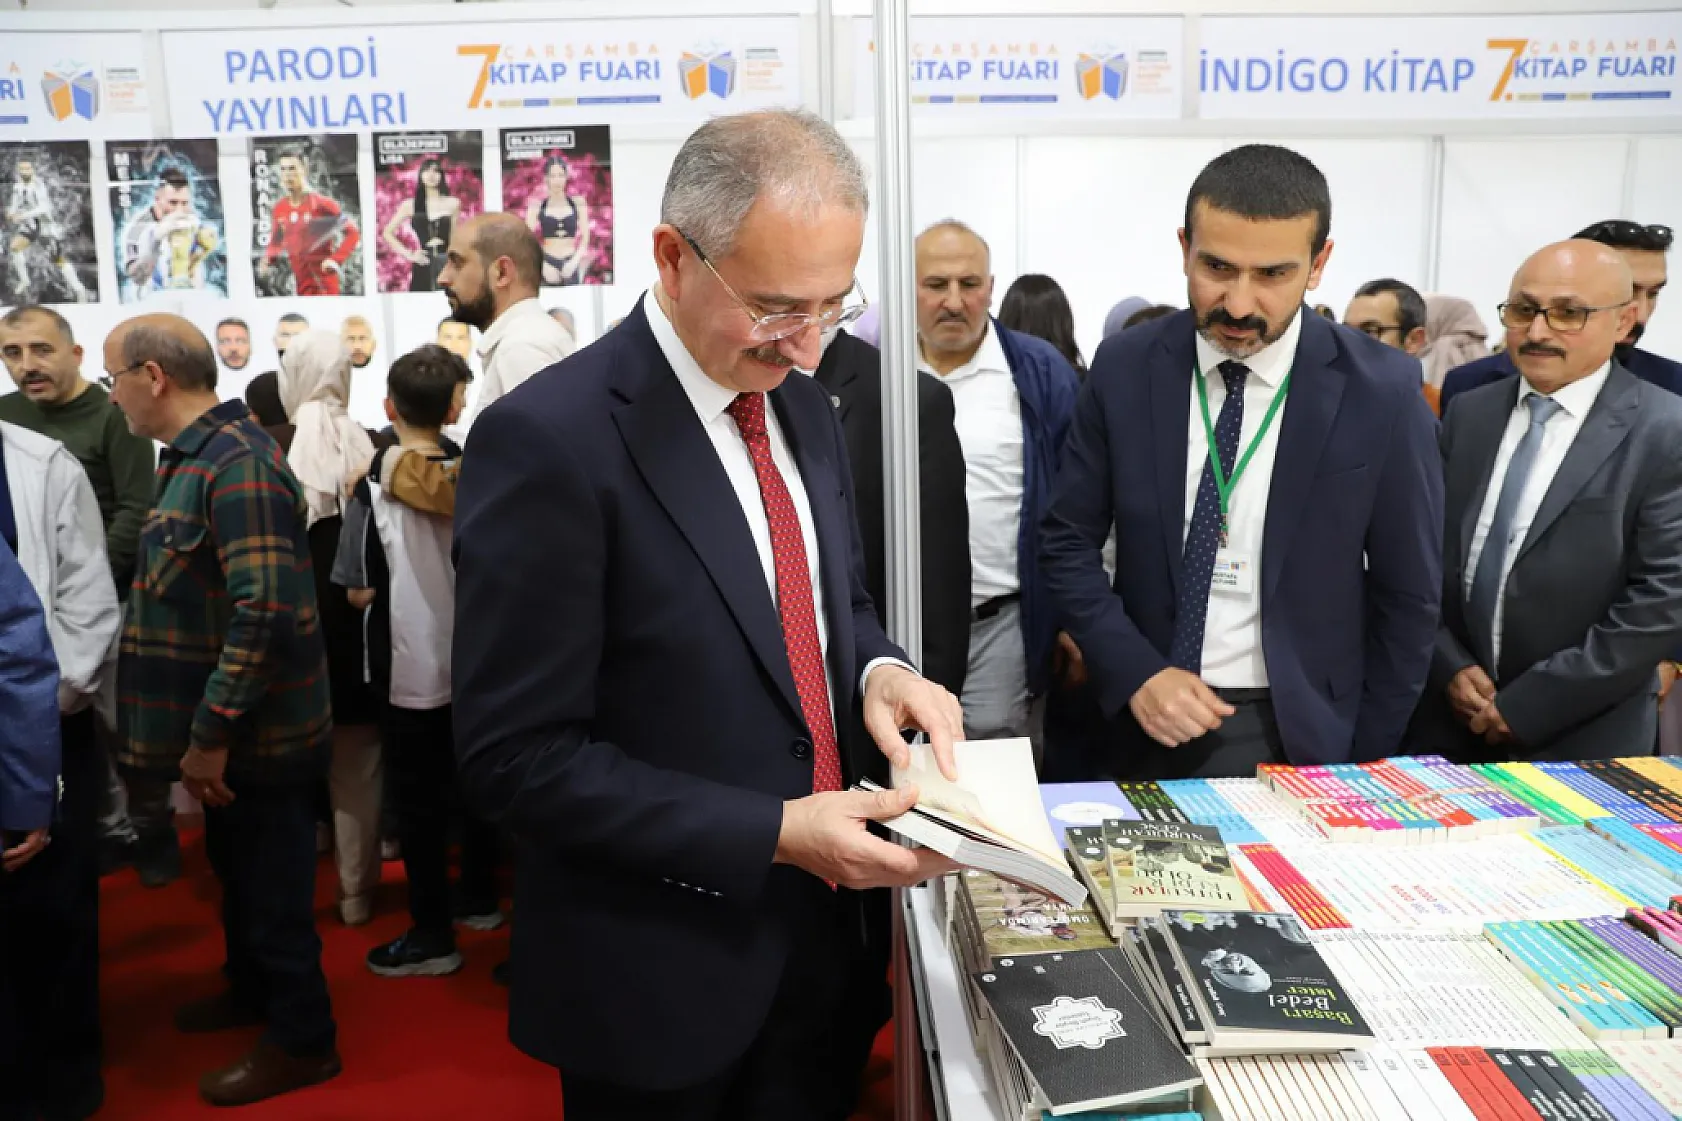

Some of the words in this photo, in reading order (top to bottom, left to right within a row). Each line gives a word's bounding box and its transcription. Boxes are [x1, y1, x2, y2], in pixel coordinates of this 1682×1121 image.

[504, 42, 660, 62] ÇARŞAMBA
[1530, 38, 1676, 56] ÇARŞAMBA
[225, 36, 377, 84] PARODİ
[983, 60, 1058, 80] FUARI
[1199, 49, 1350, 93] İNDİGO
[1364, 49, 1475, 93] KİTAP
[1514, 55, 1587, 78] KİTAP
[1598, 55, 1676, 78] FUARI
[490, 62, 567, 85] KİTAP
[580, 59, 660, 82] FUARI
[203, 91, 408, 132] YAYINLARI
[1267, 994, 1330, 1011] Bedel
